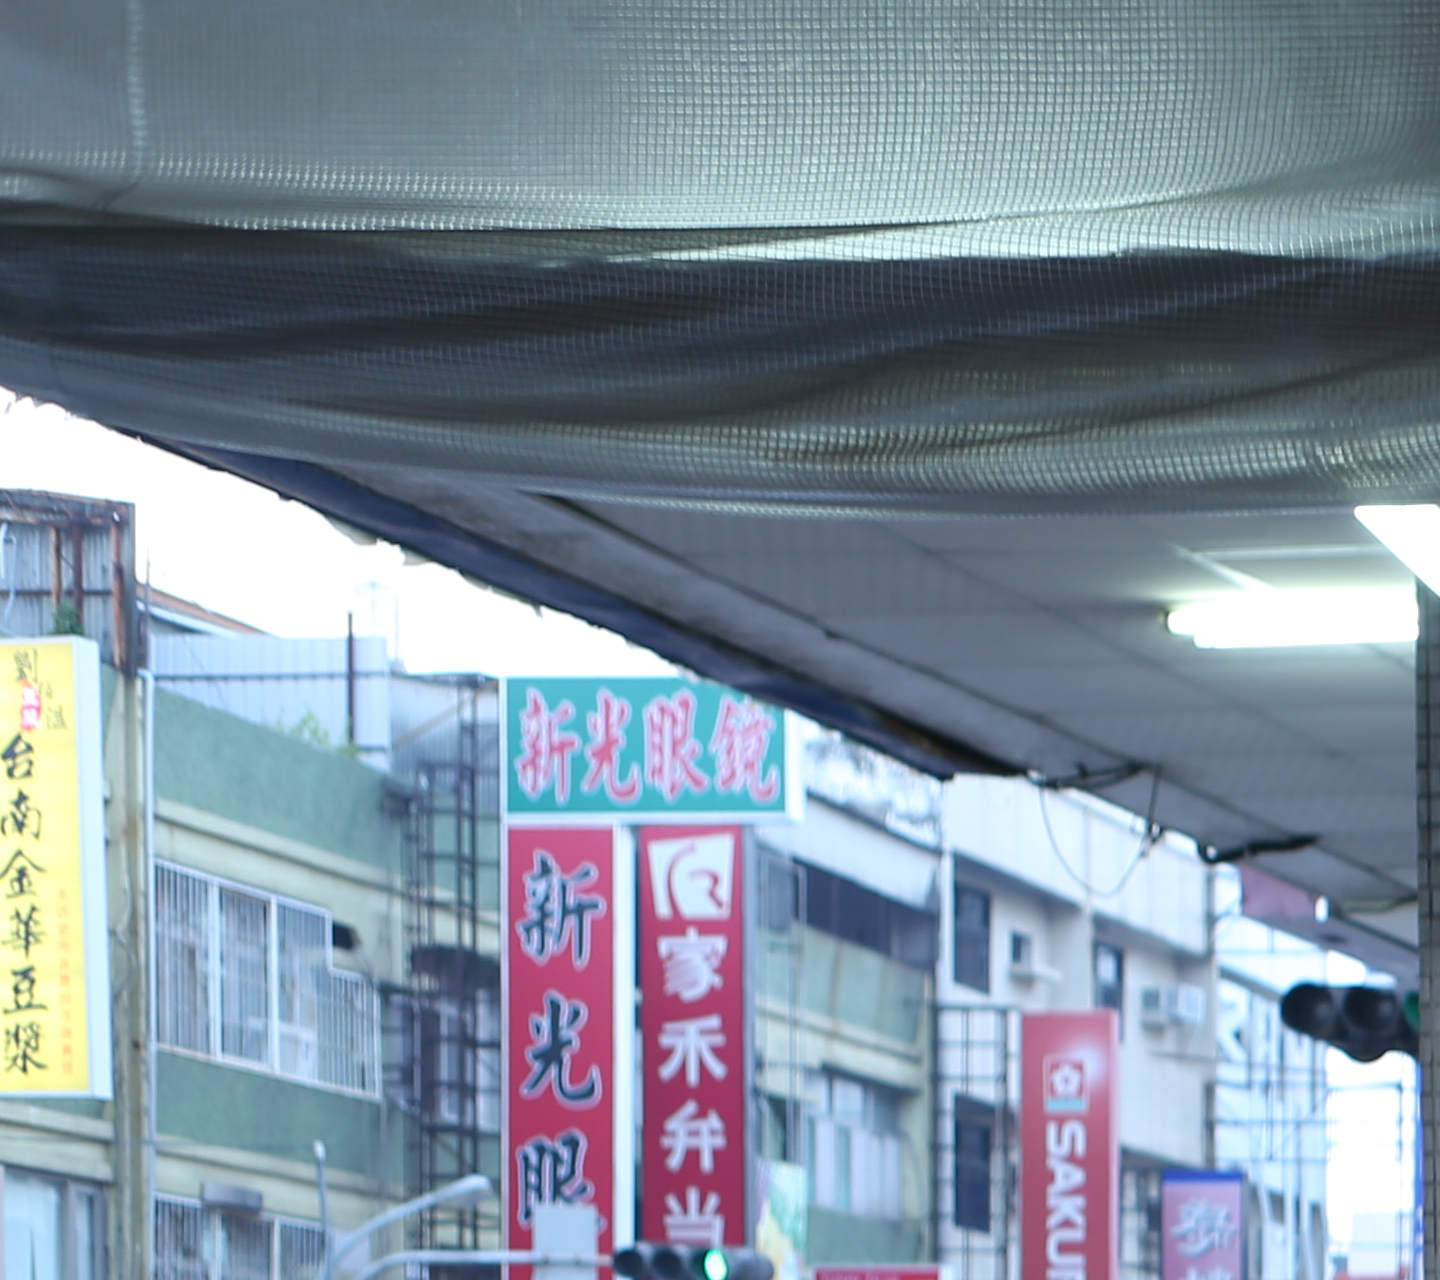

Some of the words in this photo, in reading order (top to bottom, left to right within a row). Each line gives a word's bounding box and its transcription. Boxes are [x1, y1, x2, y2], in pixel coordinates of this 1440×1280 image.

[0, 733, 48, 1076] 台南金華豆漿
[516, 687, 781, 804] 新光眼鏡
[657, 926, 729, 1244] 家禾弁当
